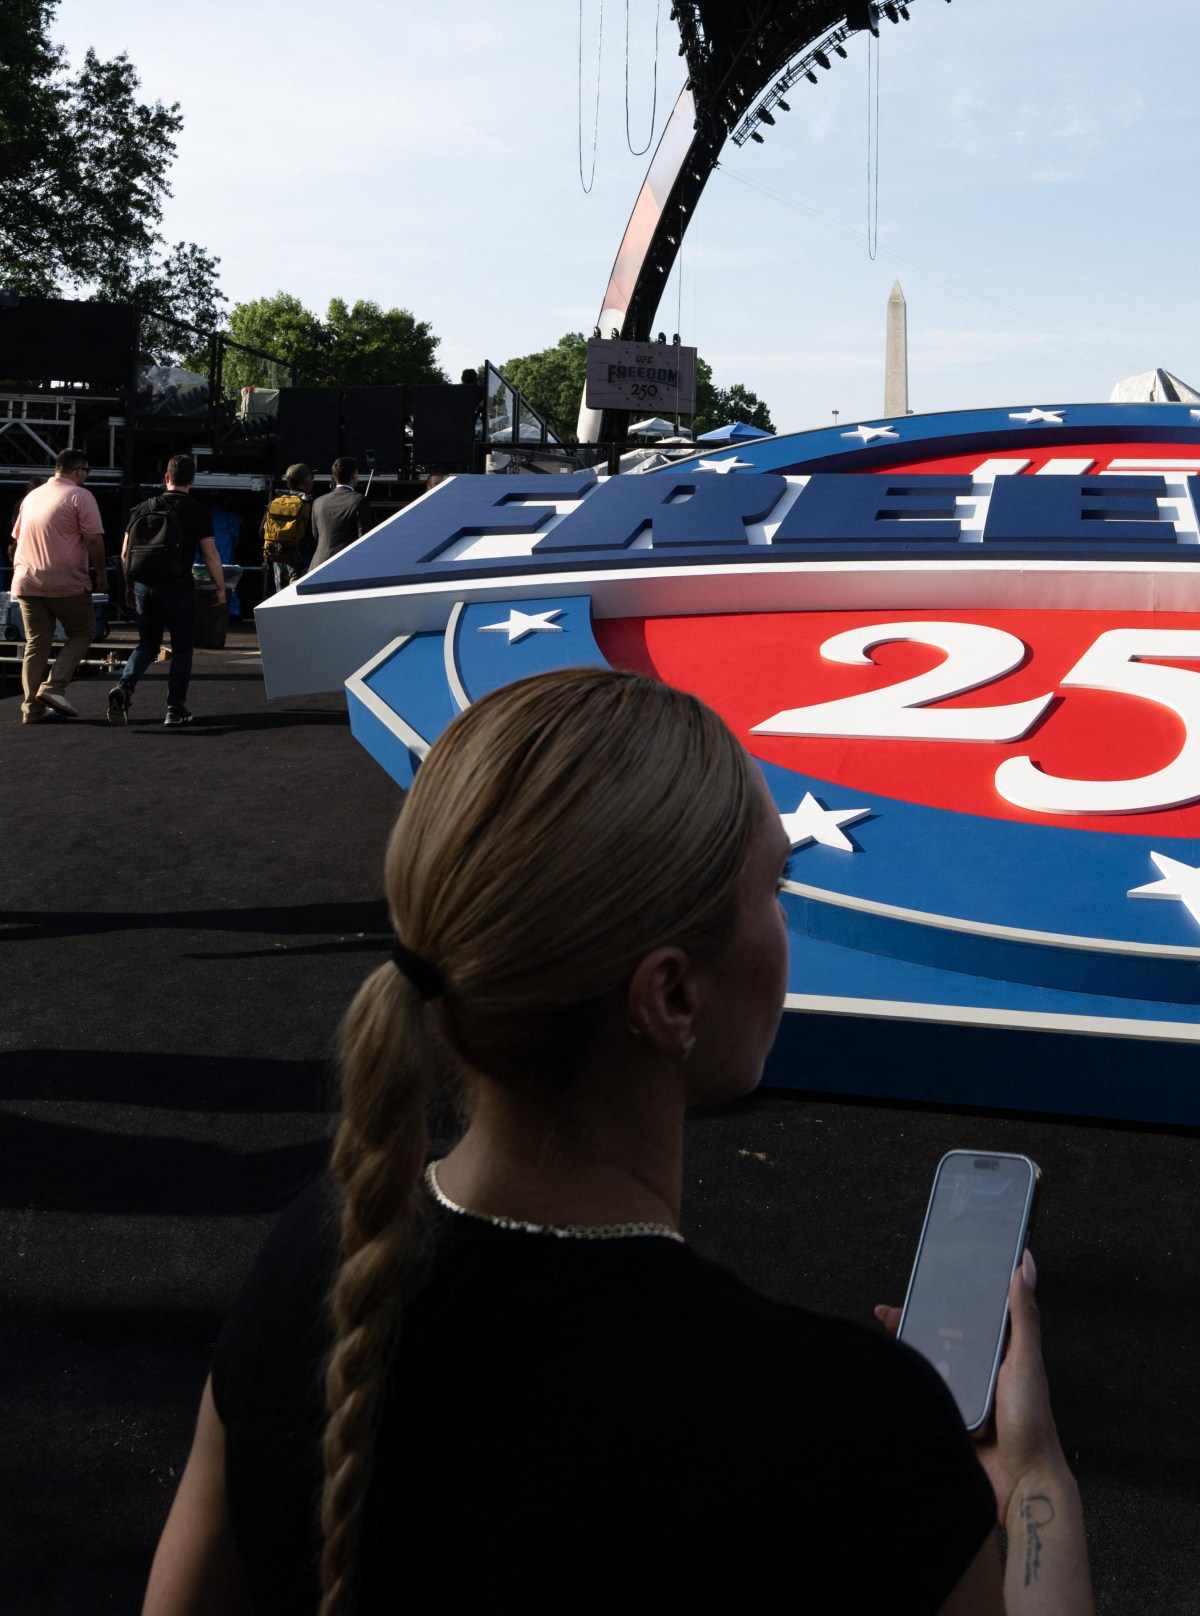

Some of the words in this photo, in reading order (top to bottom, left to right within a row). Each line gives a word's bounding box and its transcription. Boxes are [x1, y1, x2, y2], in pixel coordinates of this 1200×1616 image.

[635, 355, 654, 364] UFC
[608, 364, 678, 387] FREEDOM
[631, 383, 658, 400] 250
